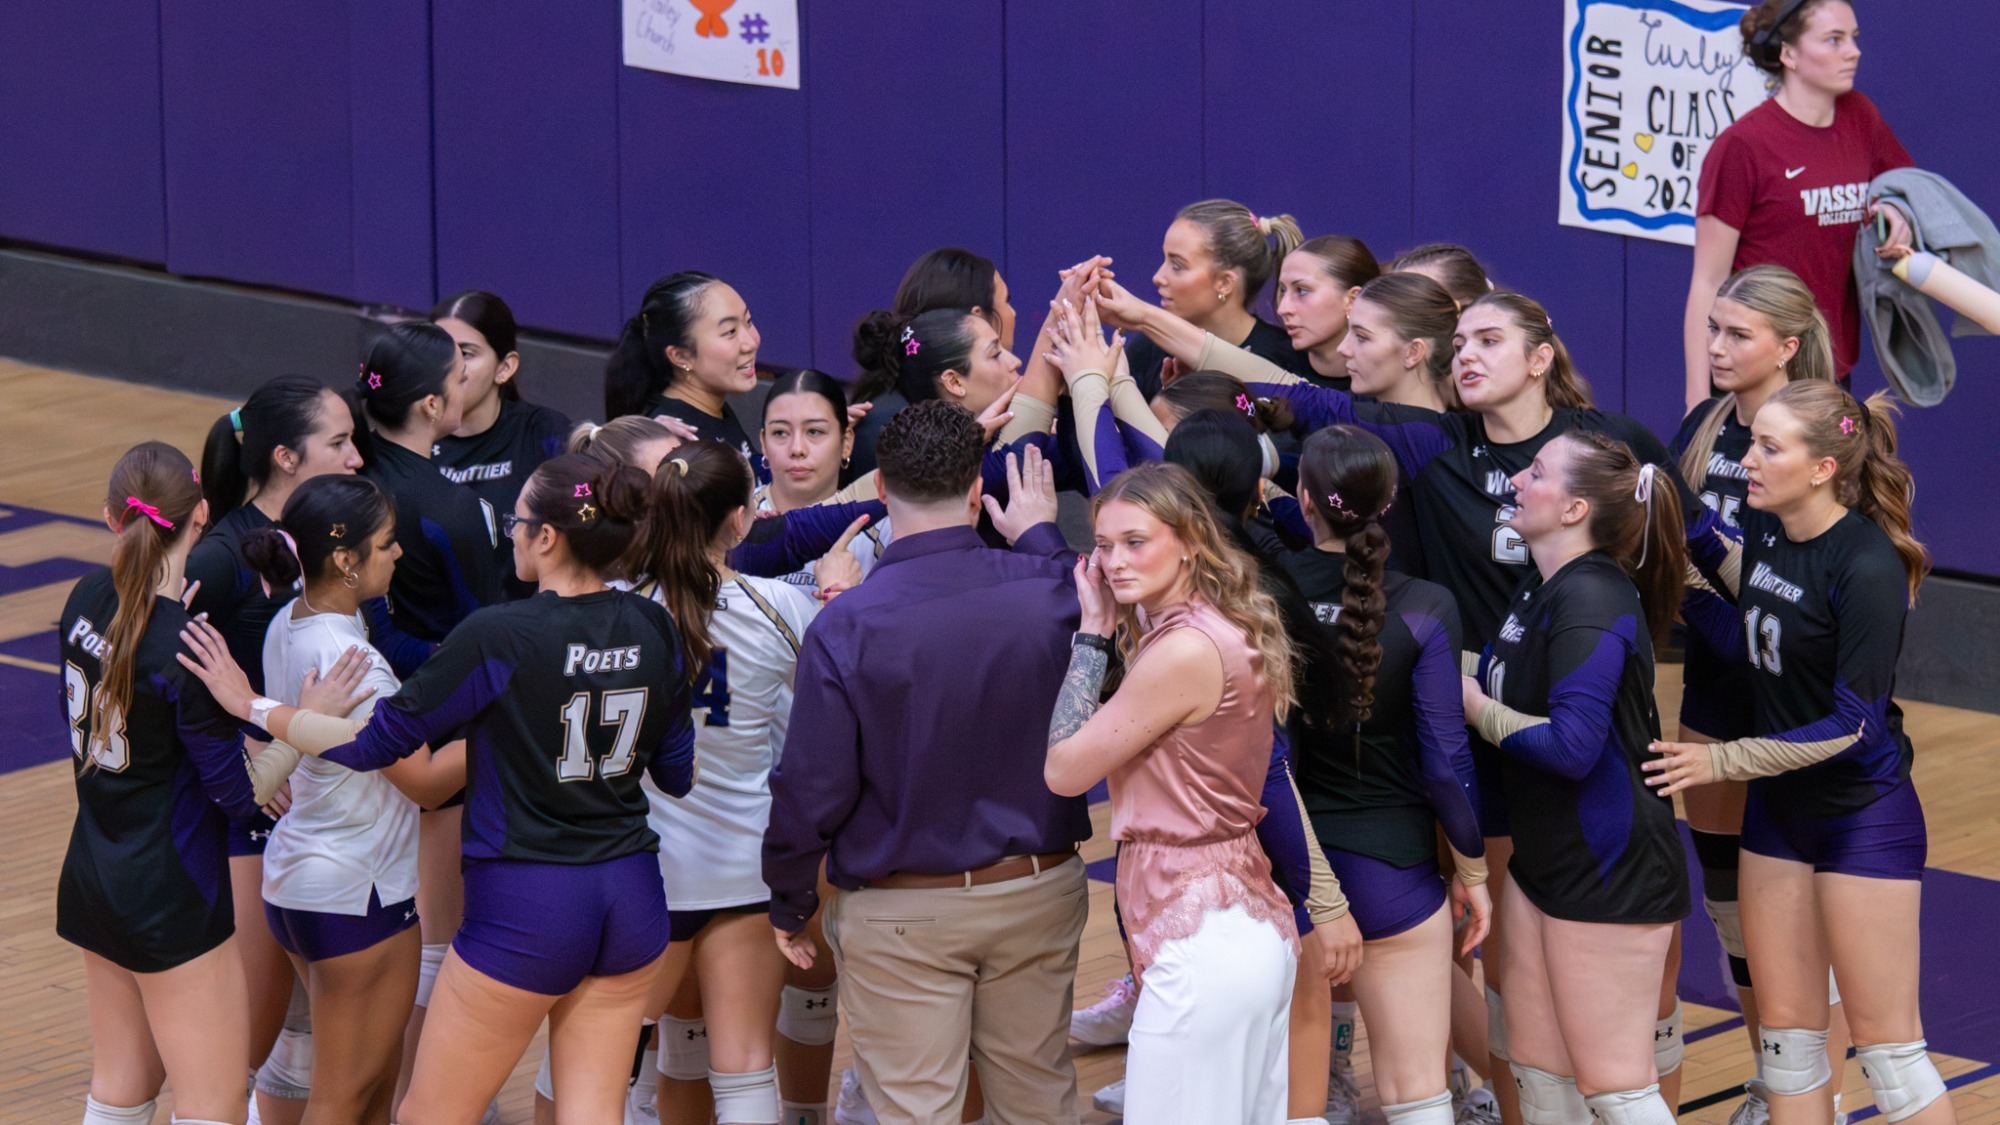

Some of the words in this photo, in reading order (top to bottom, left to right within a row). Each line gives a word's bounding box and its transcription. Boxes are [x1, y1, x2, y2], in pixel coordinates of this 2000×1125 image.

[756, 48, 784, 77] 10
[1582, 35, 1622, 197] SENIOR
[1647, 85, 1736, 140] CLASS
[1671, 141, 1697, 171] OF
[1644, 174, 1692, 211] 202
[1800, 182, 1869, 216] VASSA
[1706, 451, 1750, 481] WHITTI
[1748, 561, 1805, 604] WHITTIER
[67, 615, 113, 661] POE
[1744, 605, 1783, 677] 13
[563, 643, 641, 676] POETS
[556, 686, 649, 783] 17
